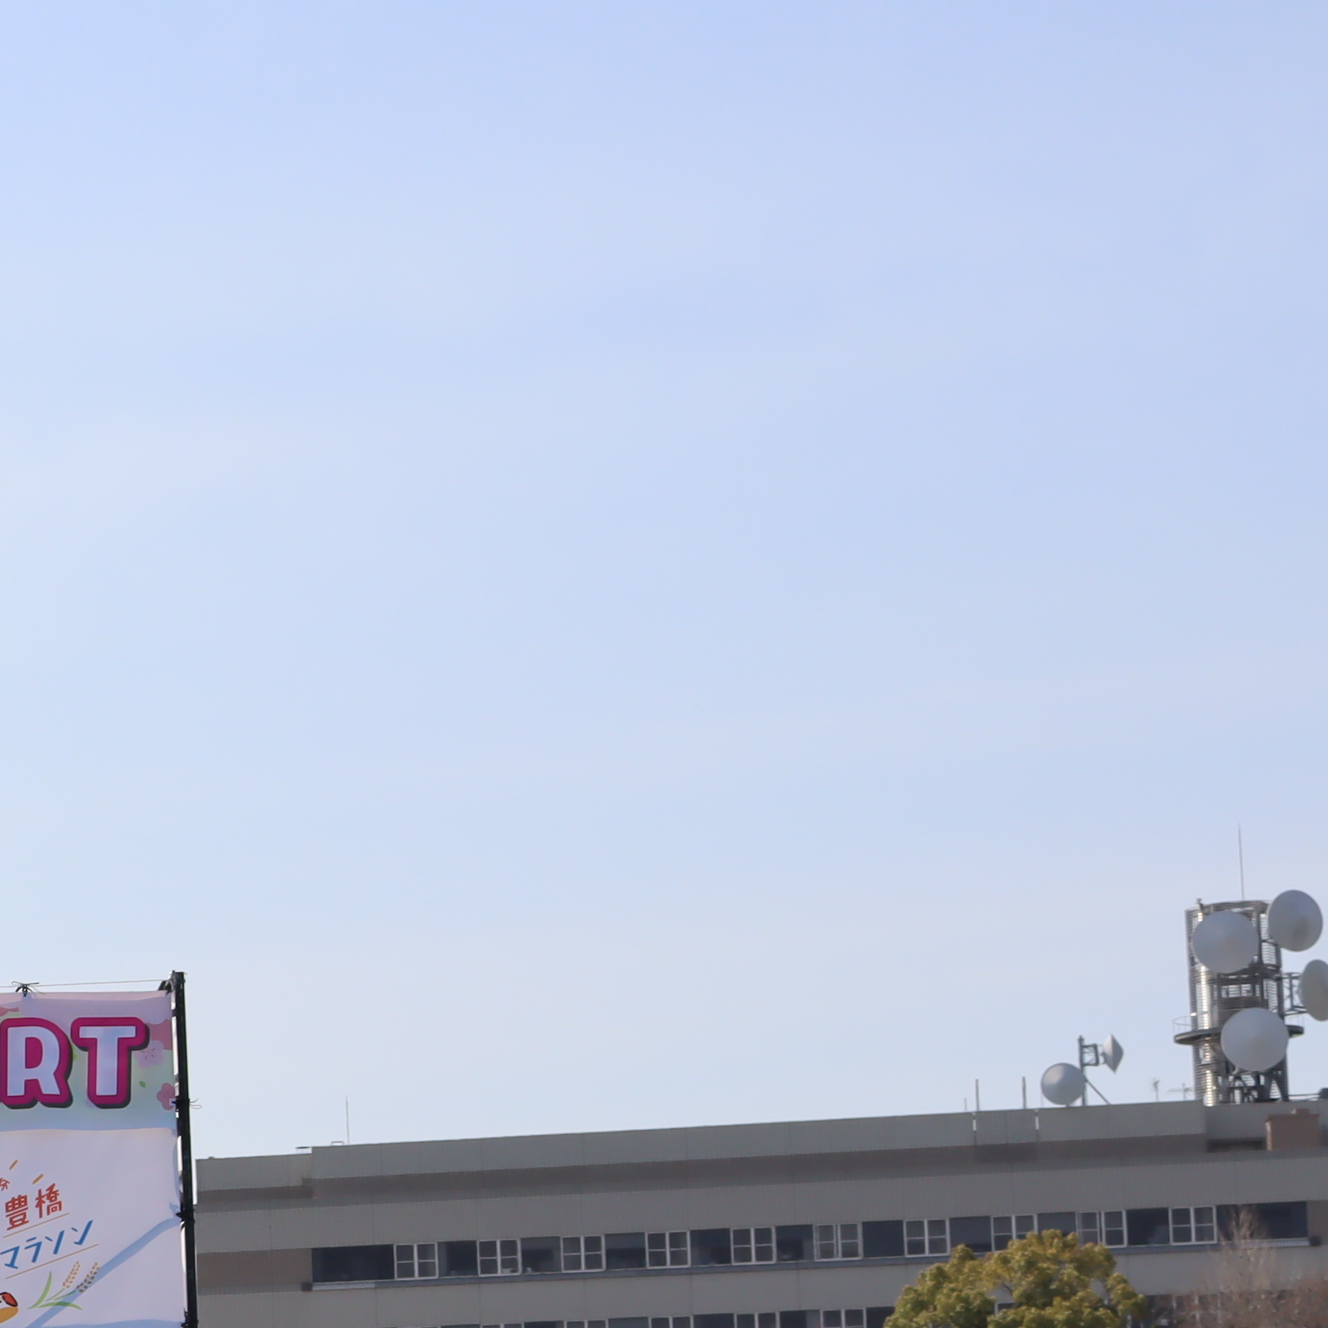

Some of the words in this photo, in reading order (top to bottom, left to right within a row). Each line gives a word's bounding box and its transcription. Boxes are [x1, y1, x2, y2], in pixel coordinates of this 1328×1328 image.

[4, 1183, 64, 1232] 豊橋
[0, 1219, 94, 1270] マラソン
